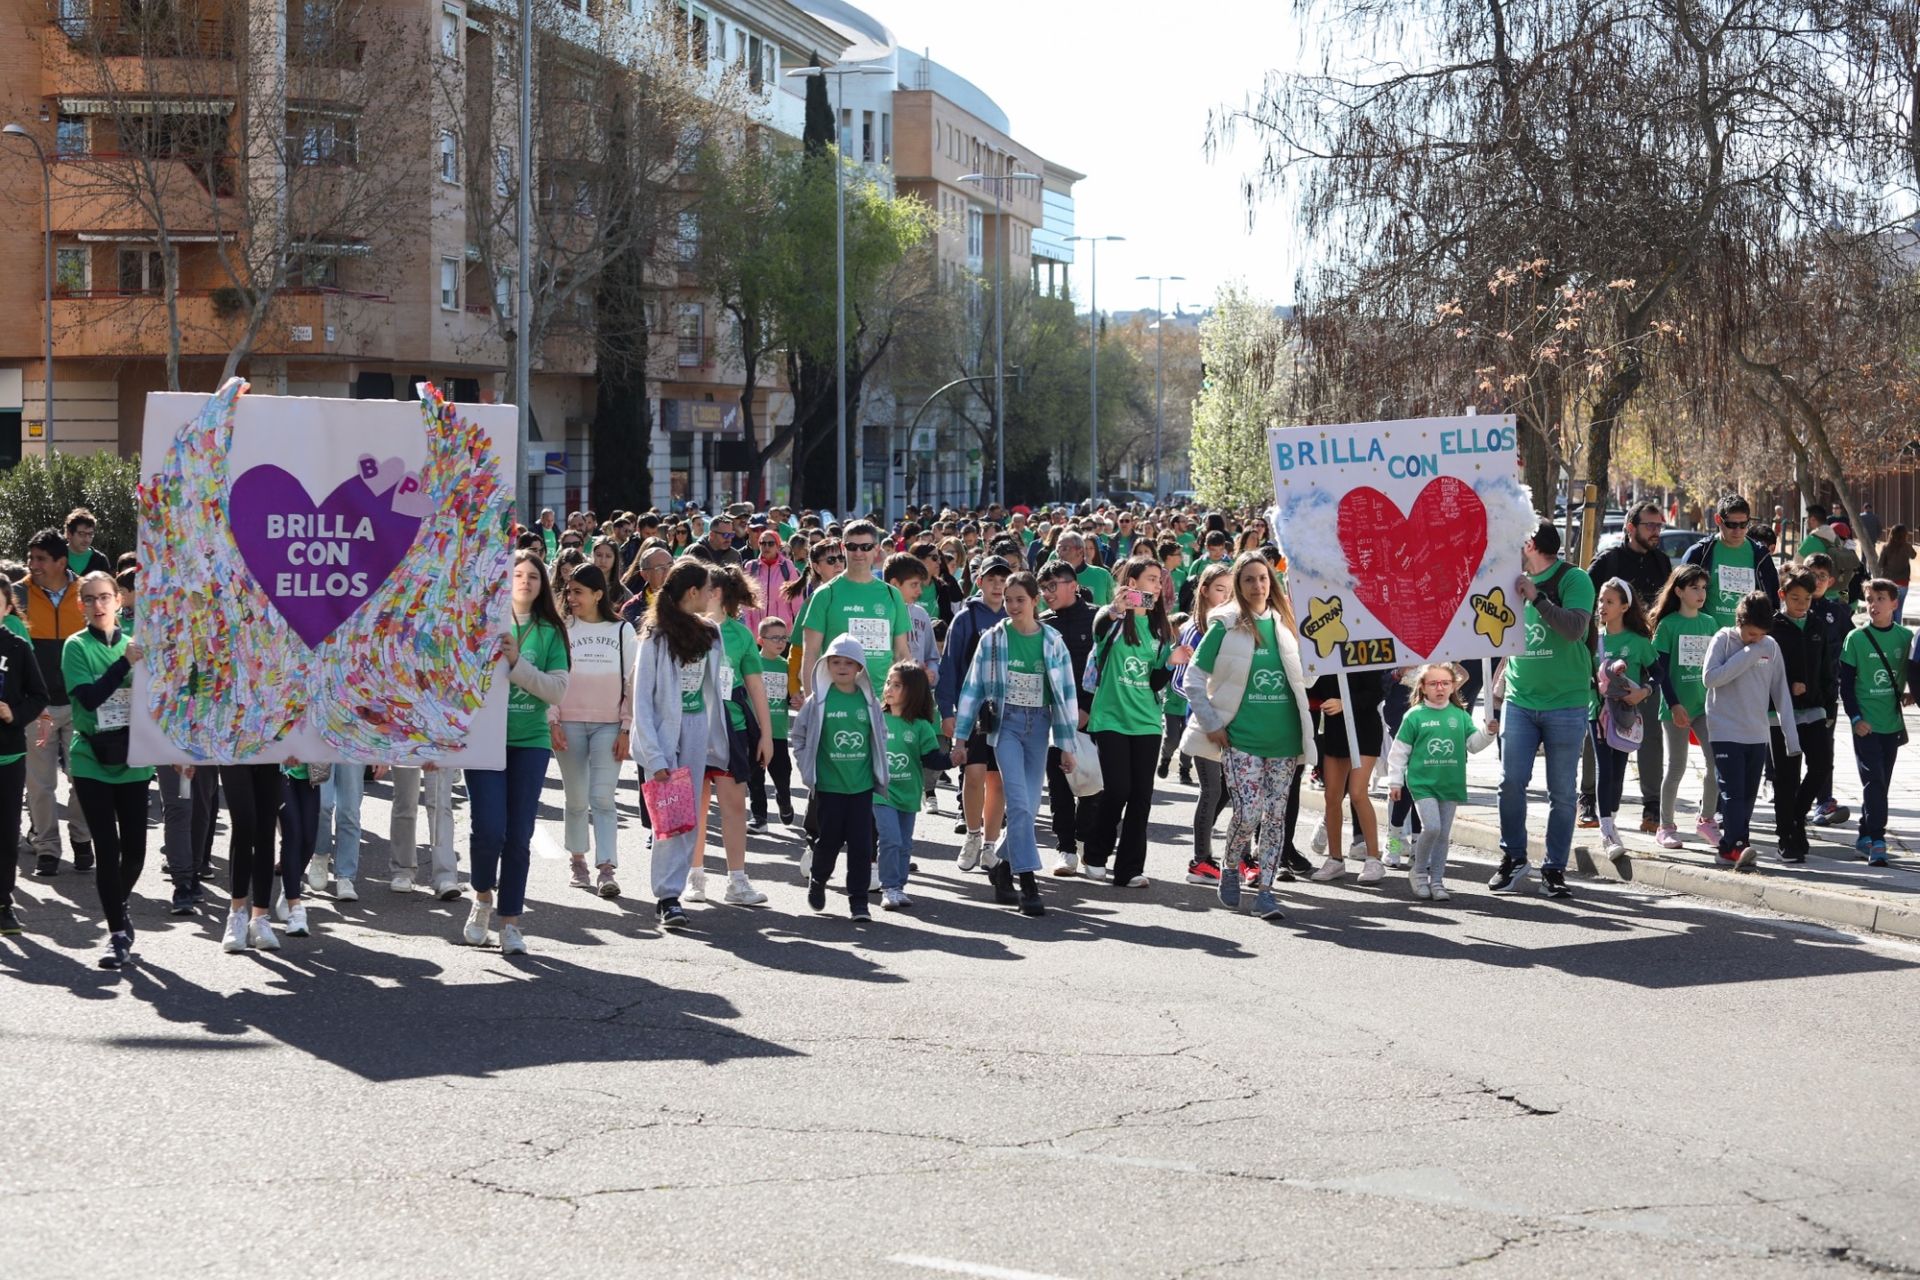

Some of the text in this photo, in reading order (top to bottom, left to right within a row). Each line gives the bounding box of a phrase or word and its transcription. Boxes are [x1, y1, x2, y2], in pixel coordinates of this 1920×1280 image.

[1276, 427, 1515, 479] BRILLA CON ELLOS
[360, 458, 378, 479] B
[398, 476, 418, 495] P
[267, 513, 375, 541] BRILLA
[287, 541, 349, 566] CON
[275, 572, 368, 598] ELLOS
[1475, 597, 1509, 623] PABLO
[1344, 640, 1393, 665] 2025
